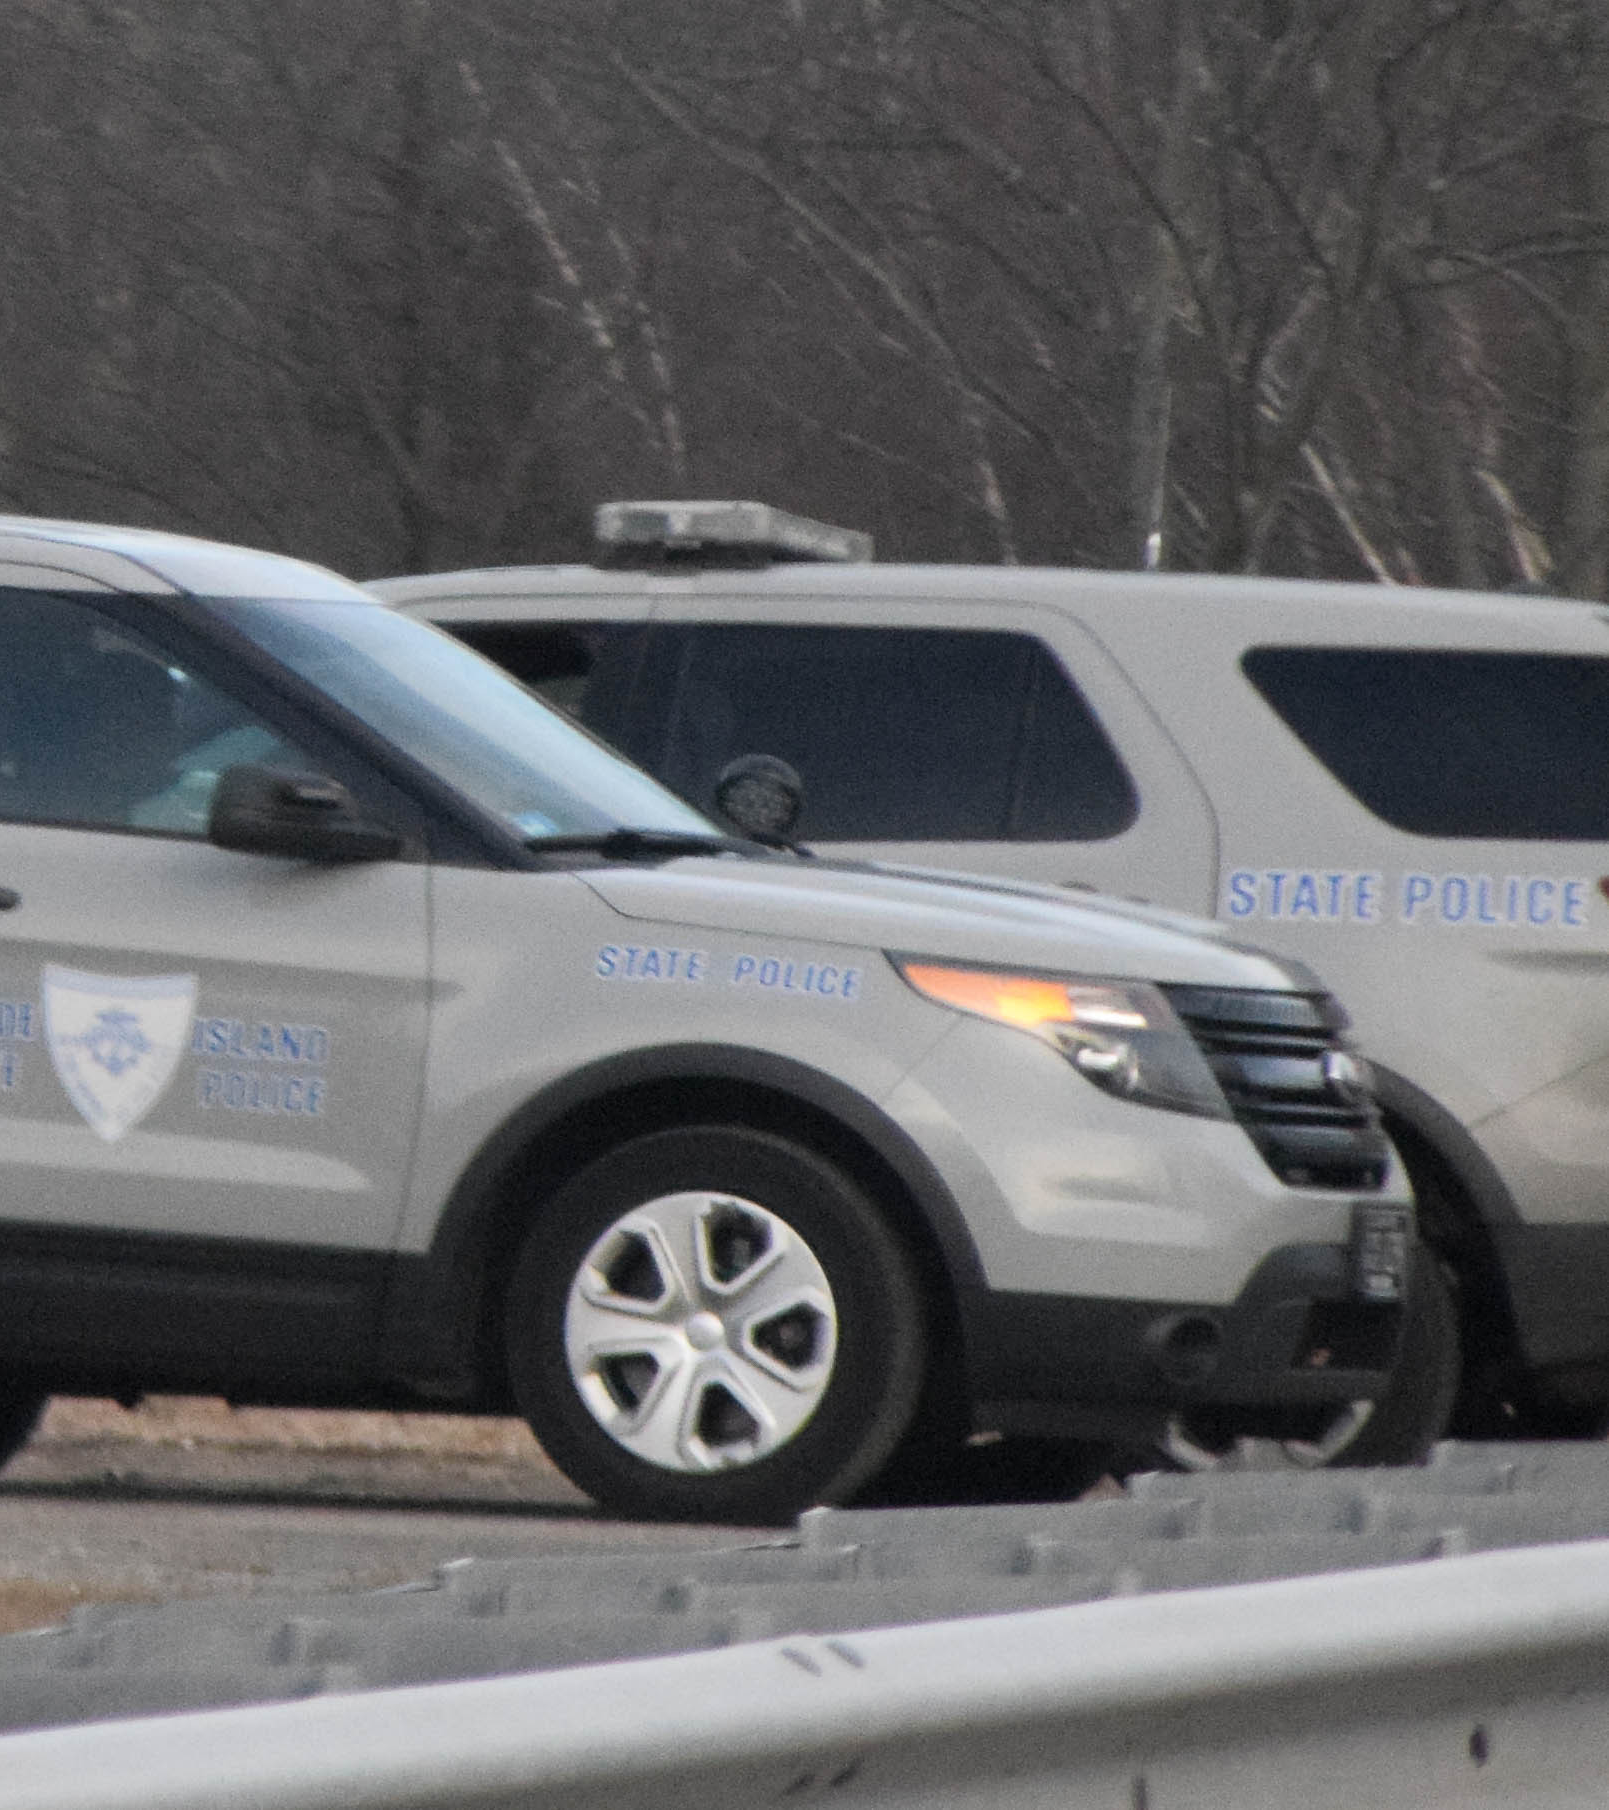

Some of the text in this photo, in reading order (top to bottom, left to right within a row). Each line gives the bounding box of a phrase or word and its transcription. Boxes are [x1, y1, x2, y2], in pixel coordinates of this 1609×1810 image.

[1228, 870, 1588, 926] STATE POLICE
[595, 944, 862, 1000] STATE POLICE
[191, 1017, 329, 1062] ISLAND
[198, 1069, 328, 1116] POLICE
